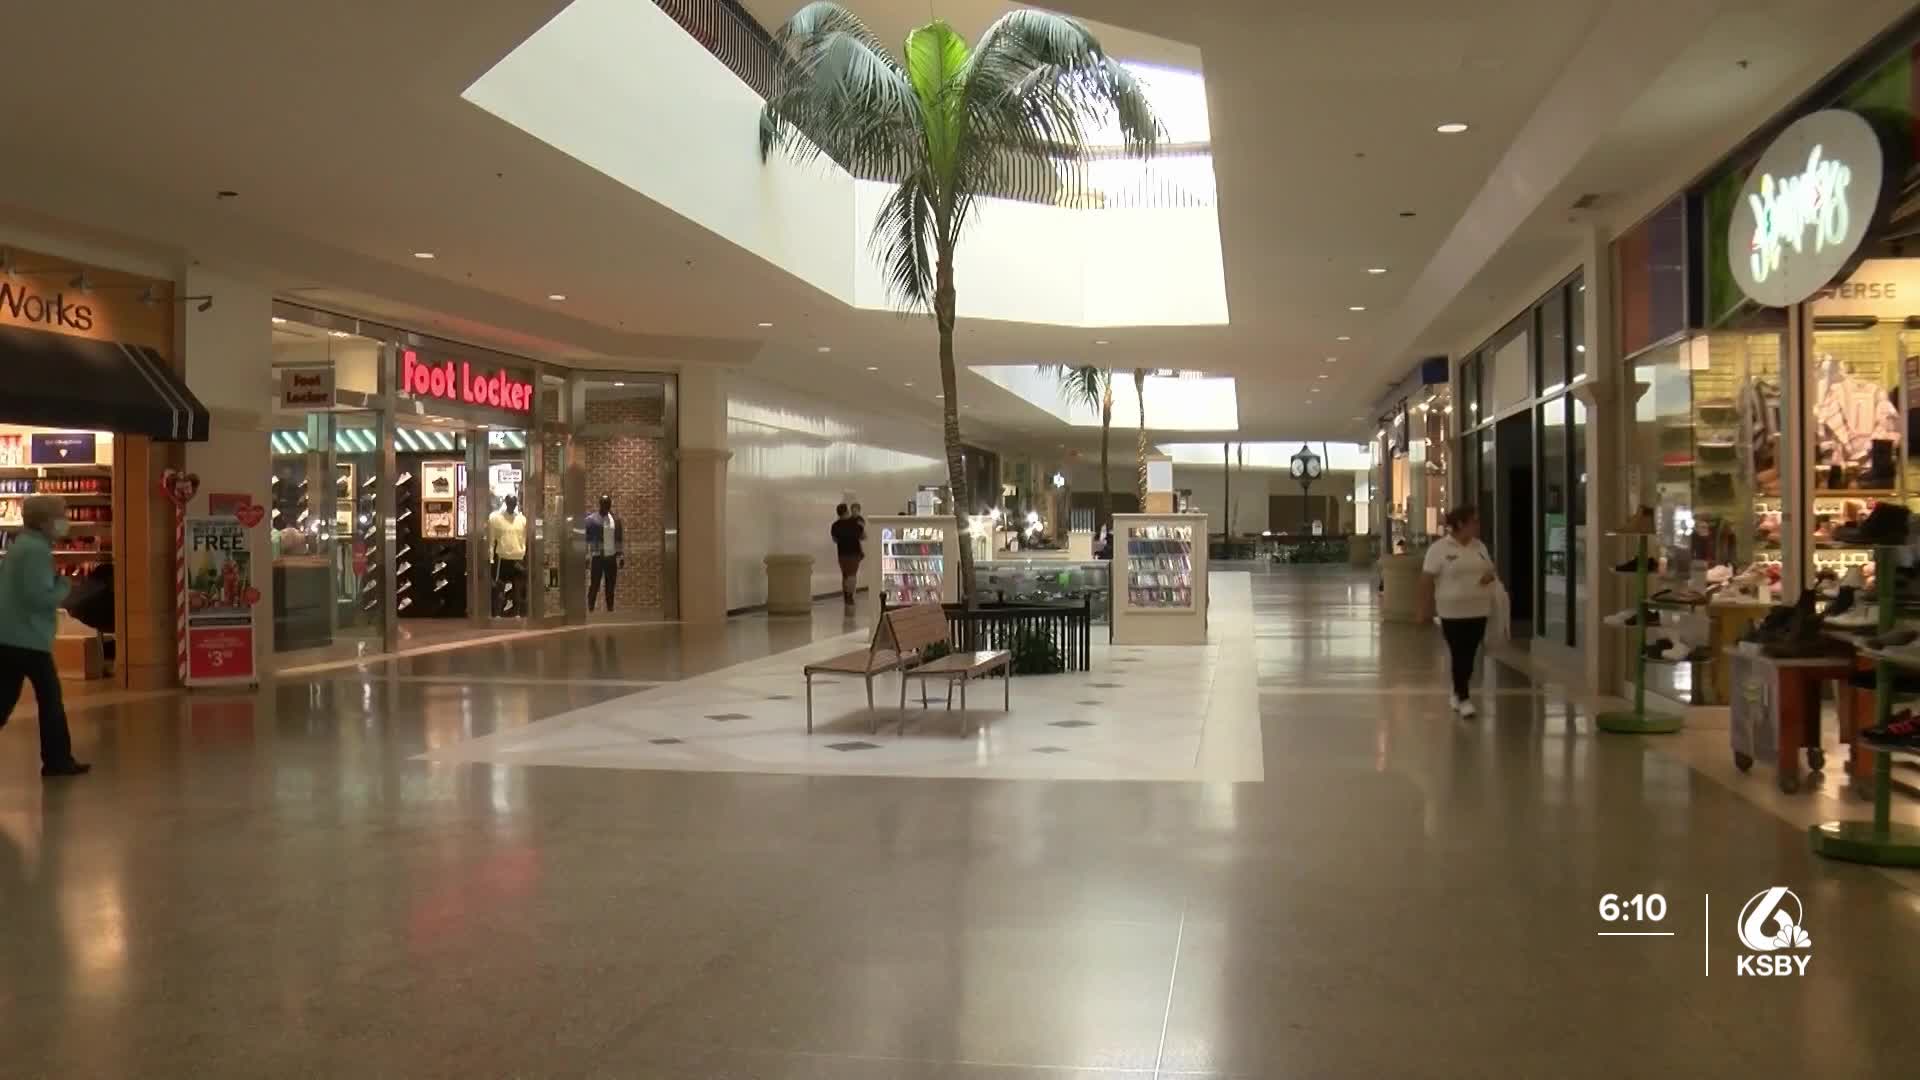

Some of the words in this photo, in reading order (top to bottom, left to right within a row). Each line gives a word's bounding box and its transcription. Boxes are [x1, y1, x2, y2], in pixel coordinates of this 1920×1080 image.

[0, 282, 94, 331] Works
[402, 350, 457, 400] Foot
[463, 361, 533, 411] Locker
[193, 535, 244, 551] FREE
